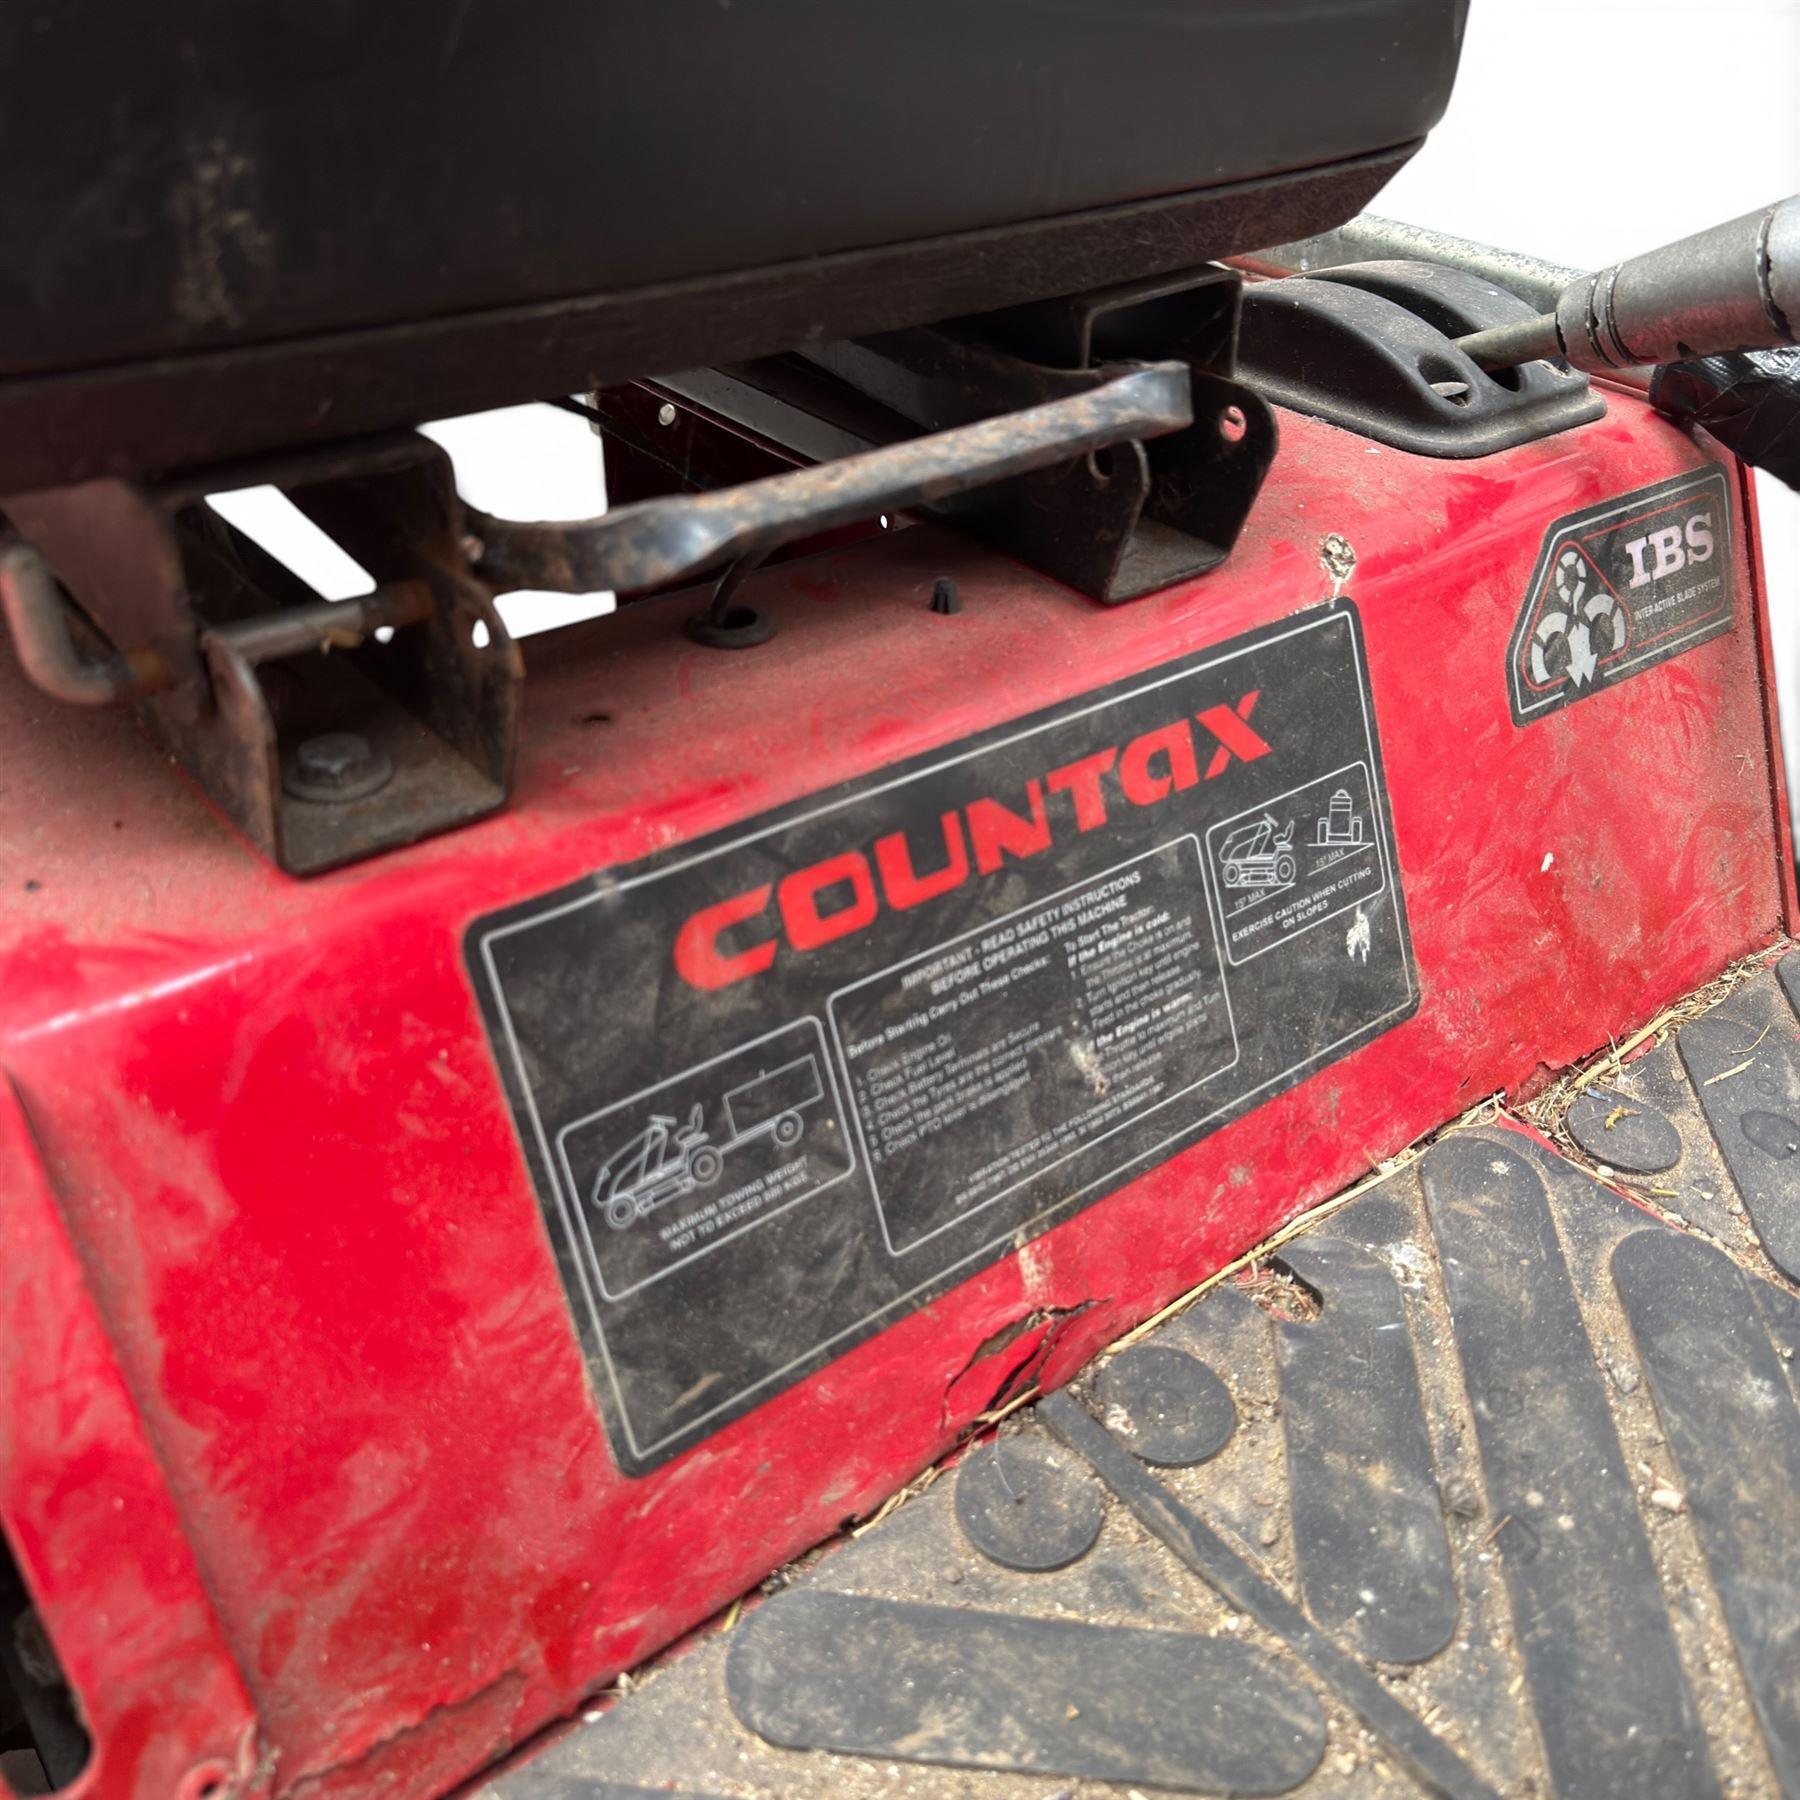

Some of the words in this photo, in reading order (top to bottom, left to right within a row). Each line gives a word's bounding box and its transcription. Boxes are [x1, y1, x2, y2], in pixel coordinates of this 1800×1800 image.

[1625, 512, 1714, 589] IBS
[1327, 847, 1344, 861] MAX
[1231, 914, 1273, 942] EXERCISE
[1274, 896, 1310, 921] CAUTION
[1312, 883, 1336, 902] WHEN
[1337, 865, 1370, 889] CUTTING
[1247, 887, 1265, 902] MAX
[1282, 916, 1294, 929] ON
[1296, 899, 1327, 922] SLOPES
[900, 946, 972, 990] IMPORTANT
[981, 927, 1015, 953] READ
[1015, 906, 1060, 937] SAFETY
[1060, 870, 1141, 917] INSTRUCTIONS
[930, 961, 981, 995] BEFORE
[981, 929, 1050, 971] OPERATING
[1050, 917, 1076, 939] THIS
[1077, 893, 1127, 927] MACHINE
[1064, 939, 1076, 953] To
[1077, 927, 1101, 947] Start
[1101, 918, 1119, 936] The
[1067, 954, 1077, 967] If
[1077, 945, 1096, 962] the
[1097, 928, 1132, 955] Engine
[1134, 922, 1143, 935] is
[1080, 953, 1110, 975] Ensure
[1112, 946, 1125, 960] the
[1127, 932, 1153, 953] Choke
[1154, 928, 1162, 939] is
[1163, 922, 1174, 935] on
[1175, 914, 1191, 929] and
[1085, 973, 1101, 988] the
[1101, 958, 1132, 981] Throttle
[1086, 985, 1106, 1003] Turn
[1138, 962, 1154, 979] key
[1153, 952, 1171, 970] until
[1173, 941, 1200, 963] engine
[1089, 998, 1112, 1017] starts
[1114, 989, 1130, 1004] and
[1131, 979, 1150, 996] then
[846, 1030, 884, 1058] Before
[885, 1010, 928, 1043] Starting
[928, 996, 957, 1022] Carry
[958, 986, 979, 1005] Out
[978, 972, 1009, 995] These
[1091, 1010, 1114, 1030] Feed
[1124, 998, 1138, 1013] the
[1139, 985, 1163, 1006] choke
[1095, 1030, 1113, 1047] the
[1115, 1012, 1149, 1040] Engine
[1150, 1006, 1160, 1019] is
[1161, 989, 1192, 1013] warm:
[1105, 1033, 1136, 1057] Throttle
[1136, 1028, 1146, 1041] to
[1146, 1008, 1185, 1036] maximum
[1186, 999, 1202, 1014] and
[1202, 989, 1221, 1006] Turn
[866, 1055, 901, 1082] Check
[901, 1038, 937, 1067] Engine
[873, 1085, 908, 1111] Check
[908, 1067, 945, 1096] Battery
[945, 1045, 989, 1076] Terminals
[990, 1036, 1007, 1053] are
[1007, 1019, 1040, 1045] Secure
[1138, 1039, 1156, 1055] until
[1157, 1024, 1184, 1047] engine
[869, 1070, 904, 1097] Check
[904, 1059, 927, 1080] Fuel
[927, 1046, 955, 1069] Level
[877, 1100, 911, 1126] Check
[912, 1091, 929, 1109] the
[928, 1076, 957, 1101] Tyres
[957, 1068, 974, 1086] are
[990, 1043, 1024, 1069] correct
[1023, 1024, 1063, 1053] pressure
[880, 1114, 915, 1141] Check
[915, 1105, 932, 1123] the
[932, 1094, 954, 1117] park
[954, 1079, 983, 1104] brake
[994, 1057, 1028, 1084] applied
[884, 1128, 918, 1155] Check
[918, 1116, 942, 1137] PTO
[942, 1103, 967, 1125] lever
[658, 1201, 718, 1241] MAXIMUM
[717, 1178, 764, 1211] TOWING
[764, 1154, 809, 1186] WEIGHT
[668, 1227, 696, 1251] NOT
[696, 1218, 714, 1237] TO
[714, 1194, 762, 1228] EXCEED
